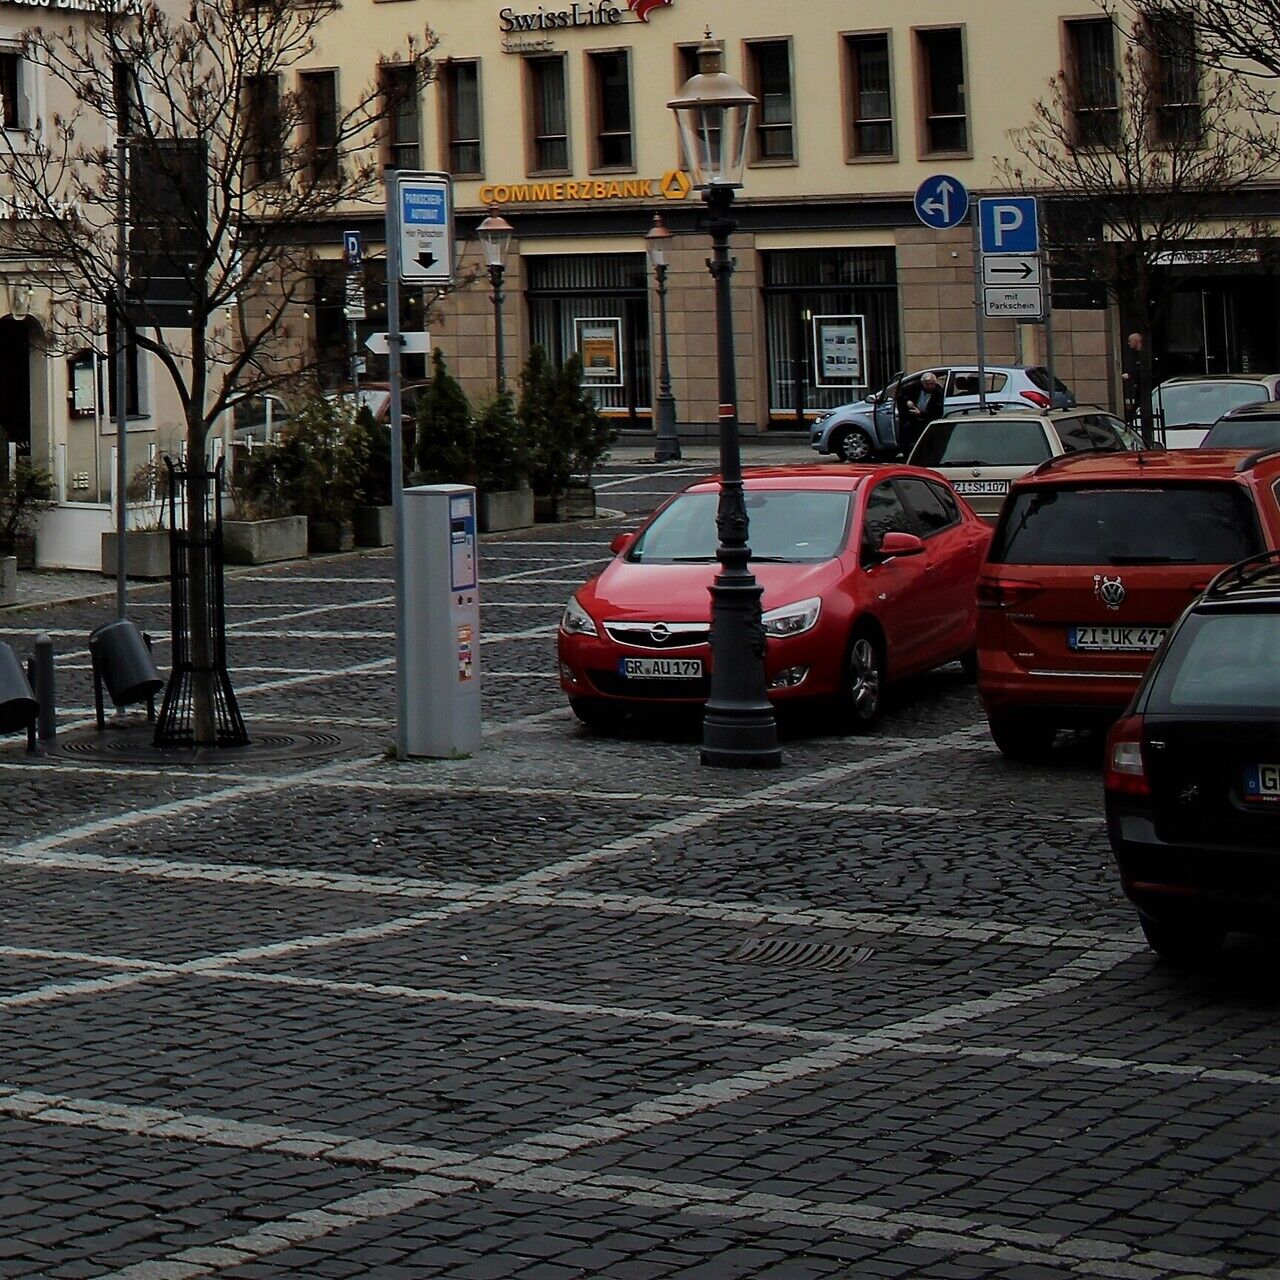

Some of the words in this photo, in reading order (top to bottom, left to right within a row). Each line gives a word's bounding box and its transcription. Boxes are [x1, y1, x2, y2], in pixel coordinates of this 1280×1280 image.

[479, 178, 653, 204] COMMERZBANK
[992, 205, 1024, 247] P
[1005, 293, 1019, 301] mit
[990, 301, 1036, 310] Parkschein
[987, 482, 1005, 492] 107
[1077, 628, 1098, 645] ZI
[1110, 629, 1133, 645] UK
[625, 660, 643, 675] GR
[652, 660, 671, 675] AU
[673, 661, 700, 676] 179
